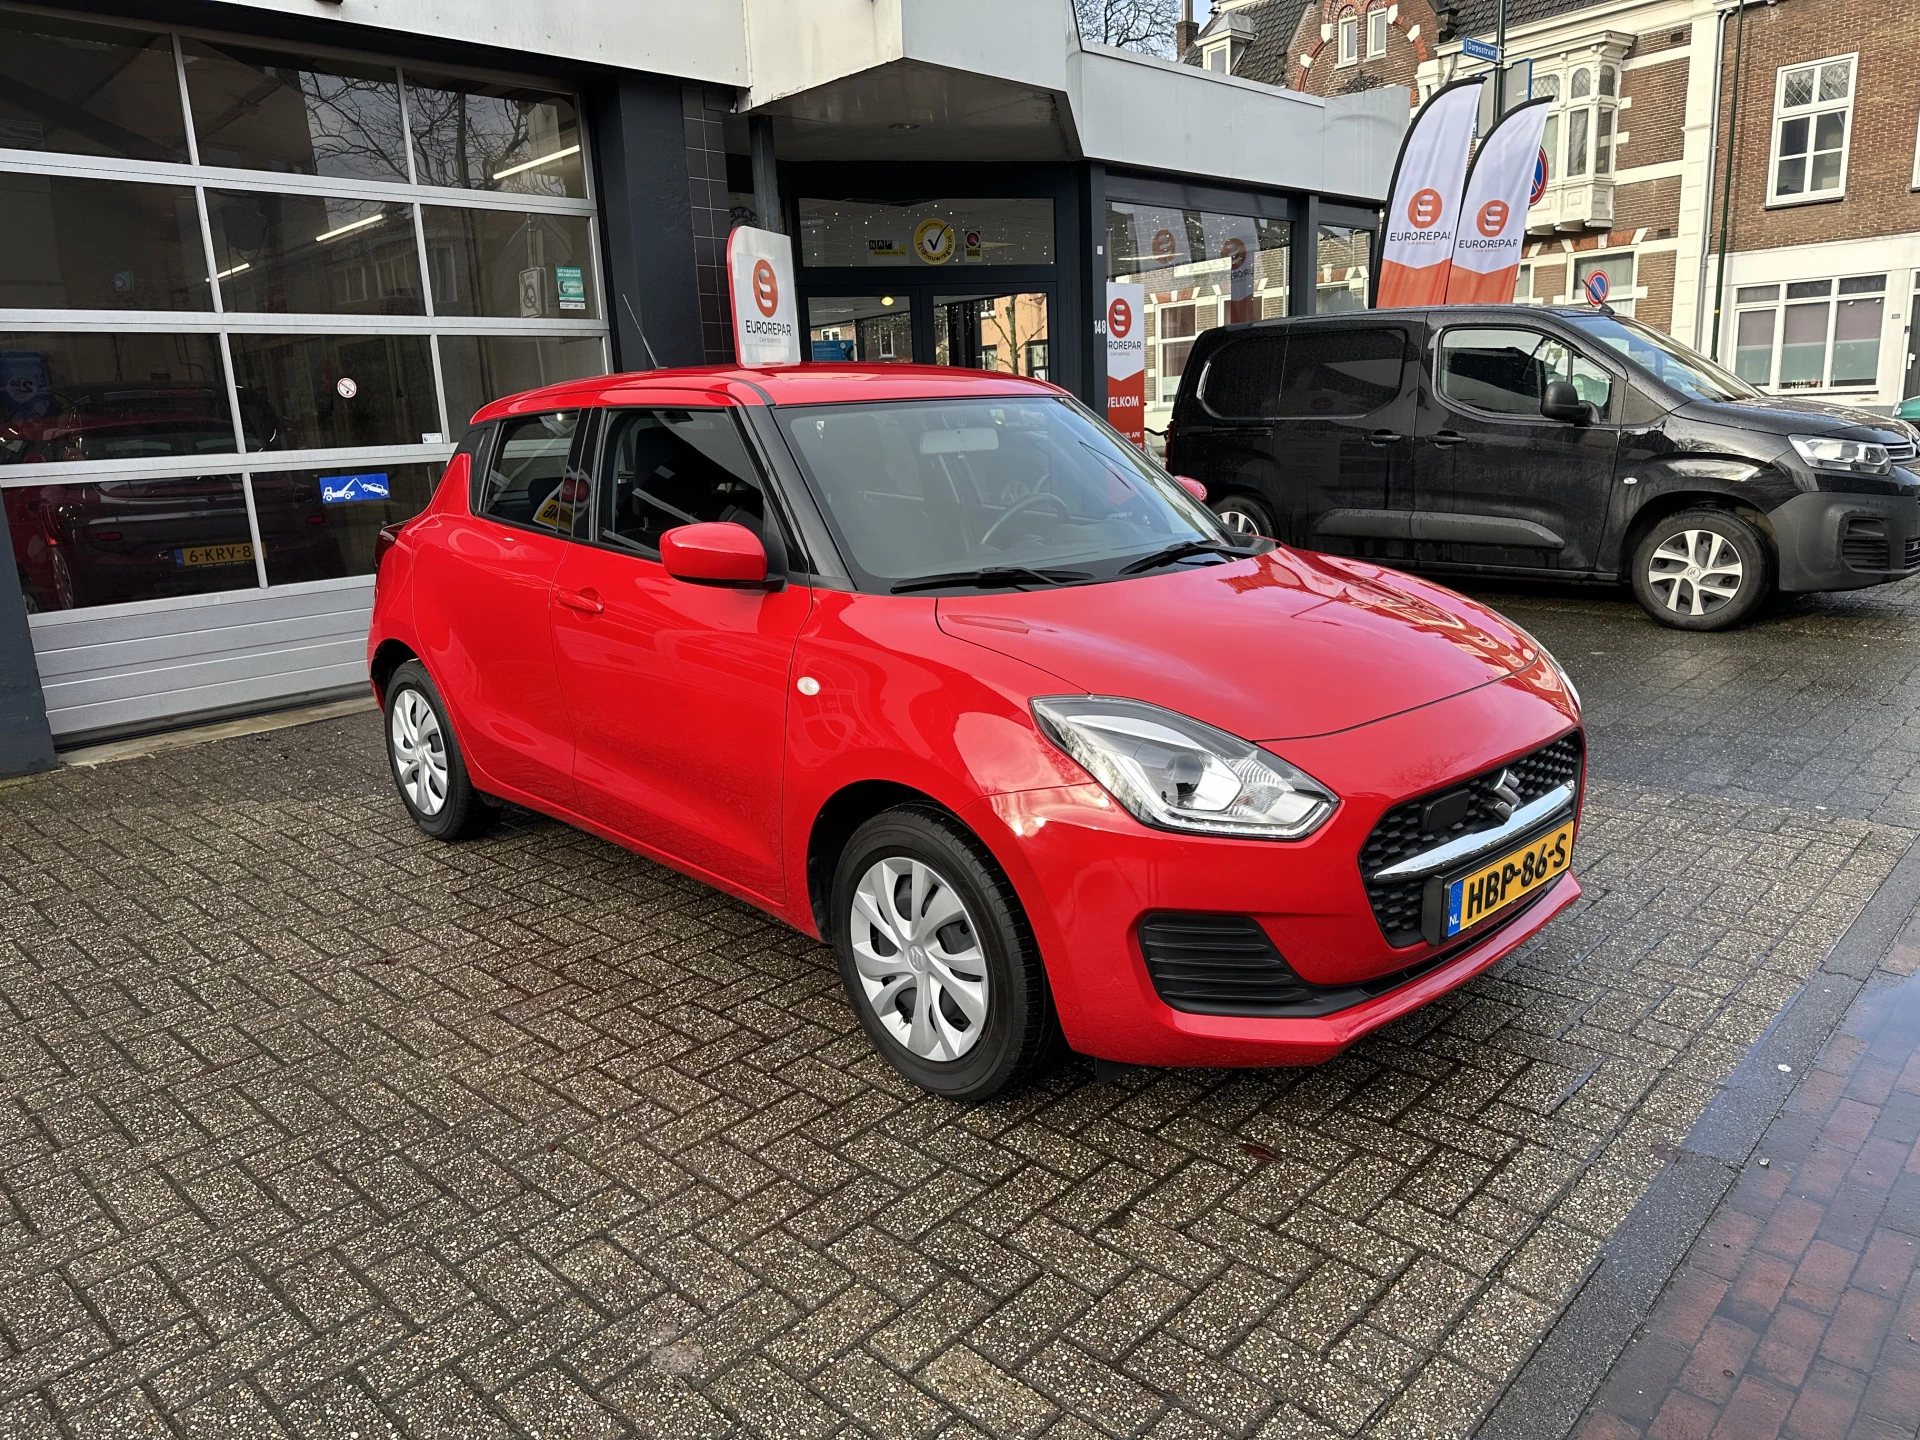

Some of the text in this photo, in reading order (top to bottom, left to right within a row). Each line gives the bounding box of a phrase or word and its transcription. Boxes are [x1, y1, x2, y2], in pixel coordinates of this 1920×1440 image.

[1468, 41, 1497, 58] Dorpsstraat
[745, 319, 792, 337] EUROREPAR
[1094, 320, 1106, 335] 148
[1107, 341, 1142, 350] ROREPAR
[189, 545, 253, 563] 6-KRV-8
[1448, 833, 1567, 927] NL HBP-86-S
